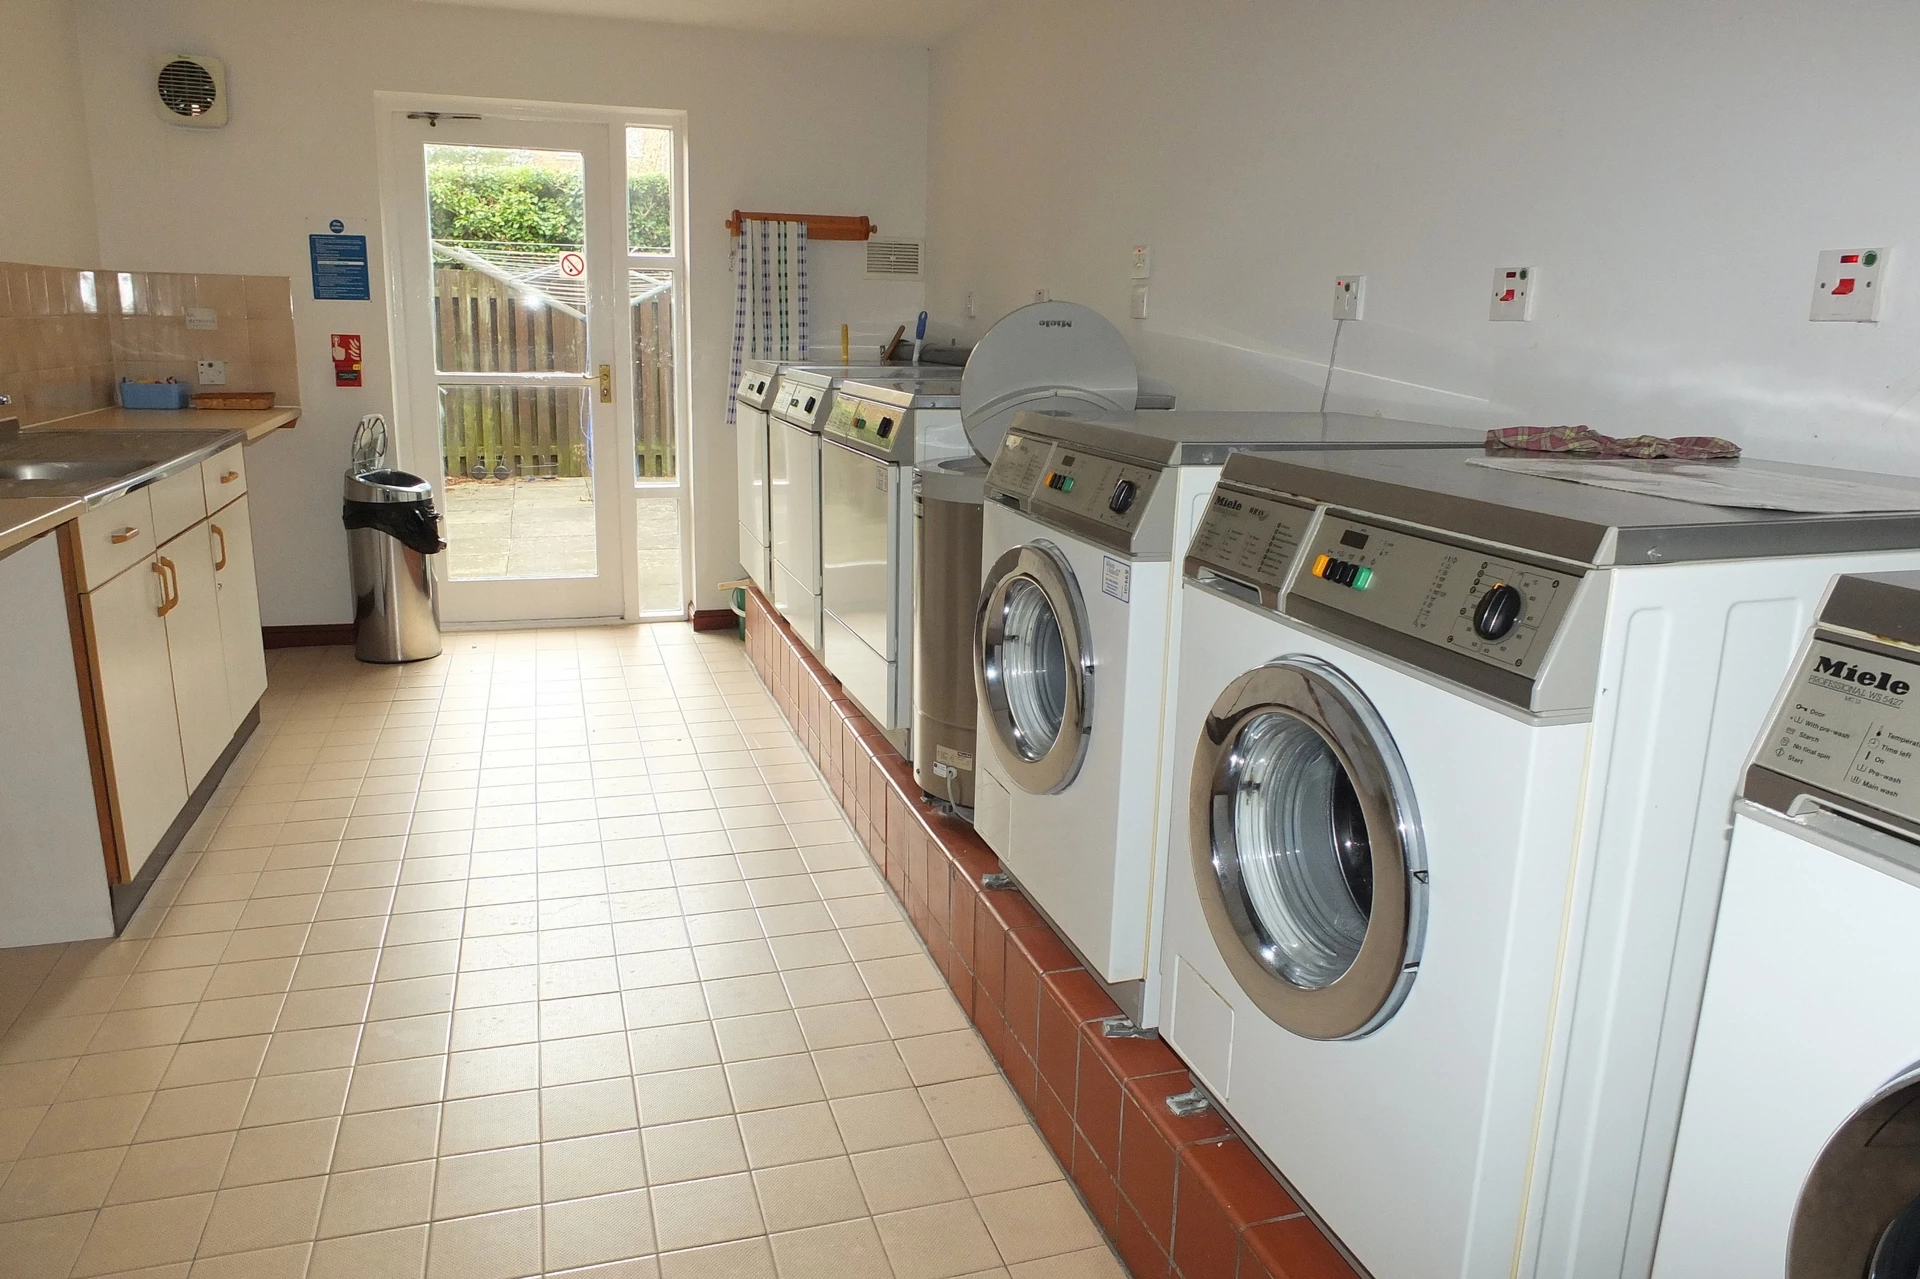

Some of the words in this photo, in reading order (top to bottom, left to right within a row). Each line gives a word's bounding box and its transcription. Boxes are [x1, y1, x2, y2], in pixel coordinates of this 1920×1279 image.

[1038, 320, 1073, 328] Miele
[1214, 496, 1243, 511] Miele
[1813, 655, 1910, 696] Miele
[1808, 674, 1866, 697] PROFESSIONAL
[1868, 691, 1883, 702] WS
[1883, 696, 1904, 707] 5427
[1810, 709, 1825, 718] Door
[1798, 731, 1820, 743] Starch
[1805, 720, 1819, 729] With
[1819, 726, 1850, 739] pre-wash
[1788, 754, 1804, 764] Start
[1802, 745, 1817, 755] final
[1816, 751, 1831, 760] spin
[1881, 744, 1899, 755] Time
[1899, 750, 1912, 759] left
[1874, 756, 1885, 764] On
[1868, 768, 1902, 784] Pre-wash
[1861, 780, 1879, 791] Main
[1880, 787, 1899, 797] wash
